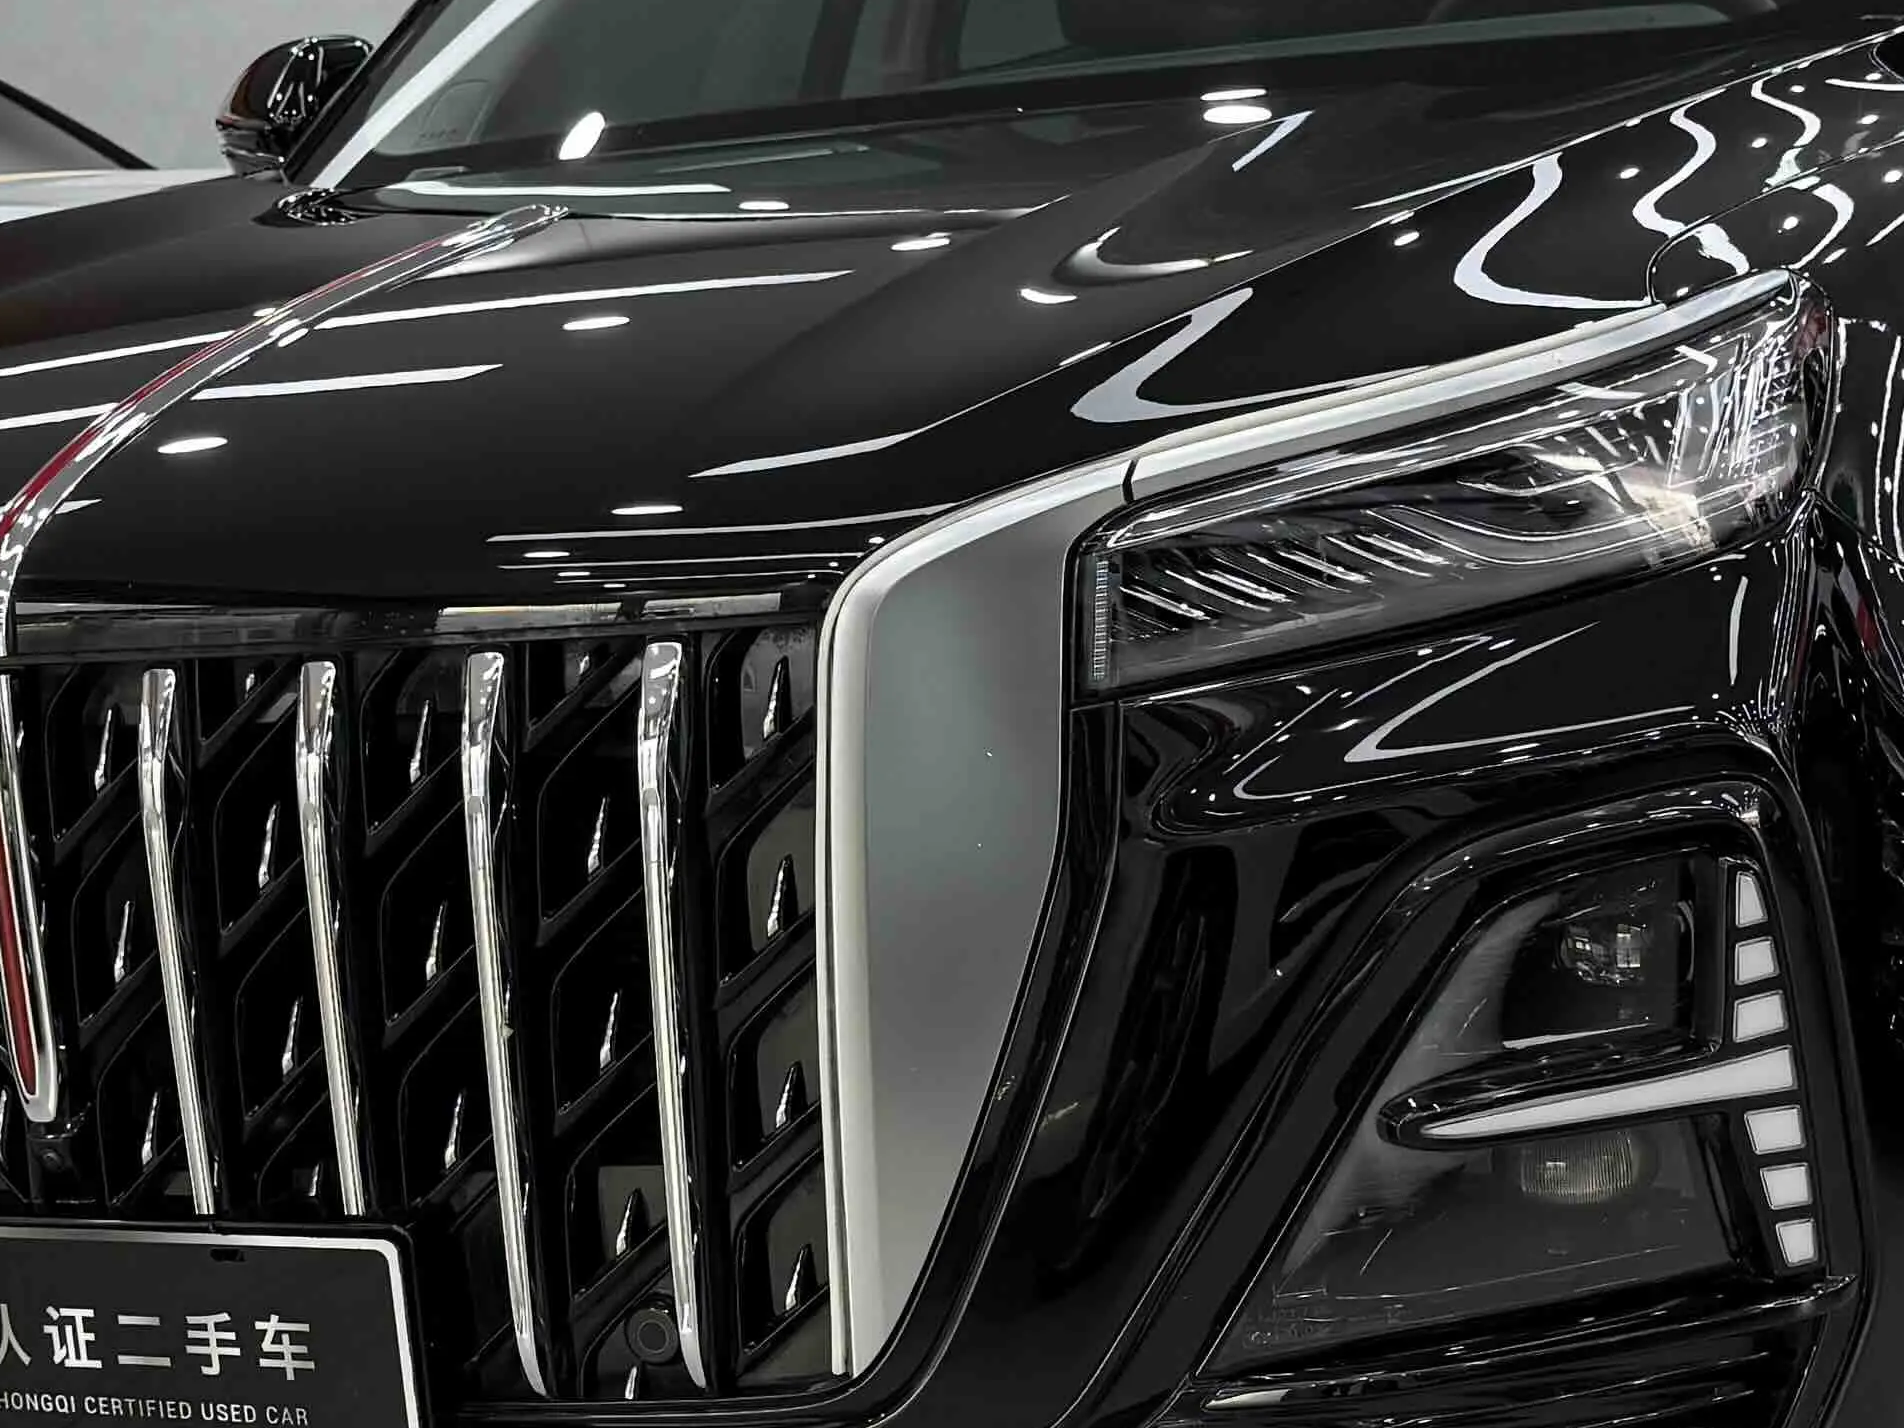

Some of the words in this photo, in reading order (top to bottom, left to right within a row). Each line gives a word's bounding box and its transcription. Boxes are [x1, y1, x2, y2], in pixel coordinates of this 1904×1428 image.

[83, 1396, 192, 1420] CERTIFIED
[200, 1401, 257, 1425] USED
[265, 1406, 309, 1427] CAR
